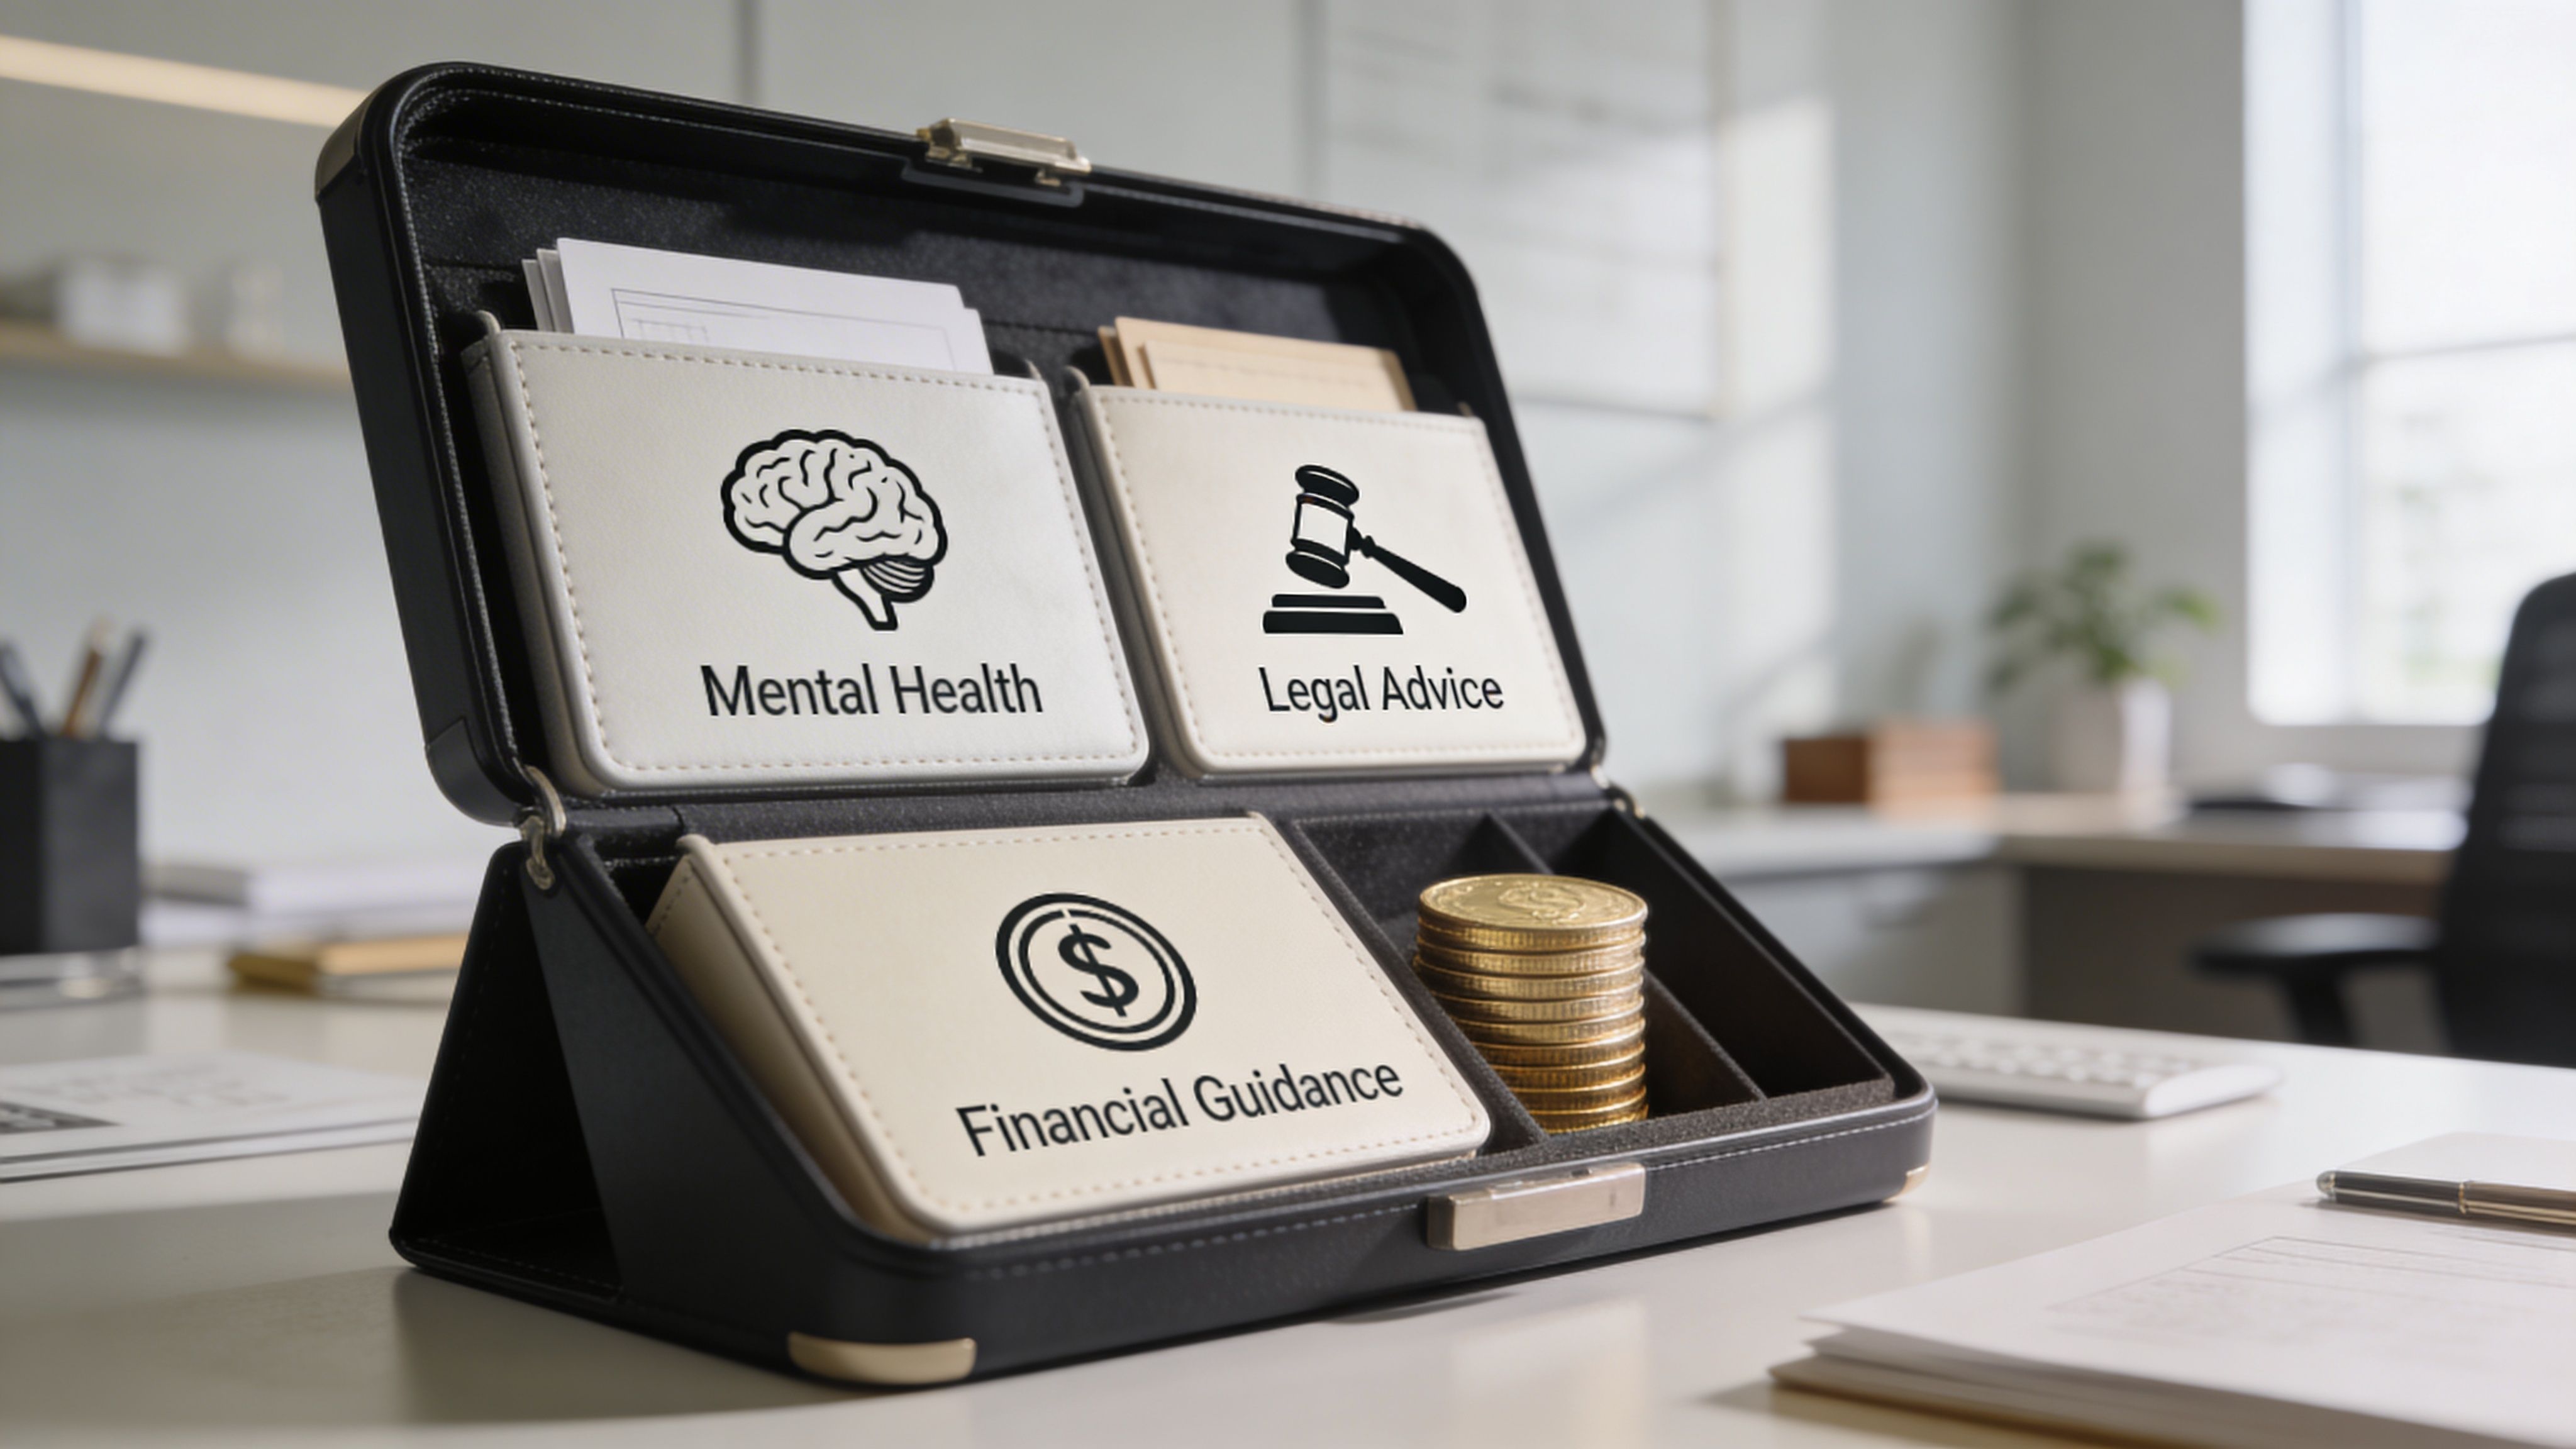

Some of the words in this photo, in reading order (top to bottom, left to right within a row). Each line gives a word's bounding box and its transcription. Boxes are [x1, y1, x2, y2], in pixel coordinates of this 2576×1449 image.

[699, 662, 880, 716] Mental
[888, 662, 1044, 714] Health
[1258, 664, 1371, 724] Legal
[1382, 664, 1504, 711] Advice
[955, 1077, 1190, 1157] Financial
[1192, 1063, 1404, 1123] Guidance
